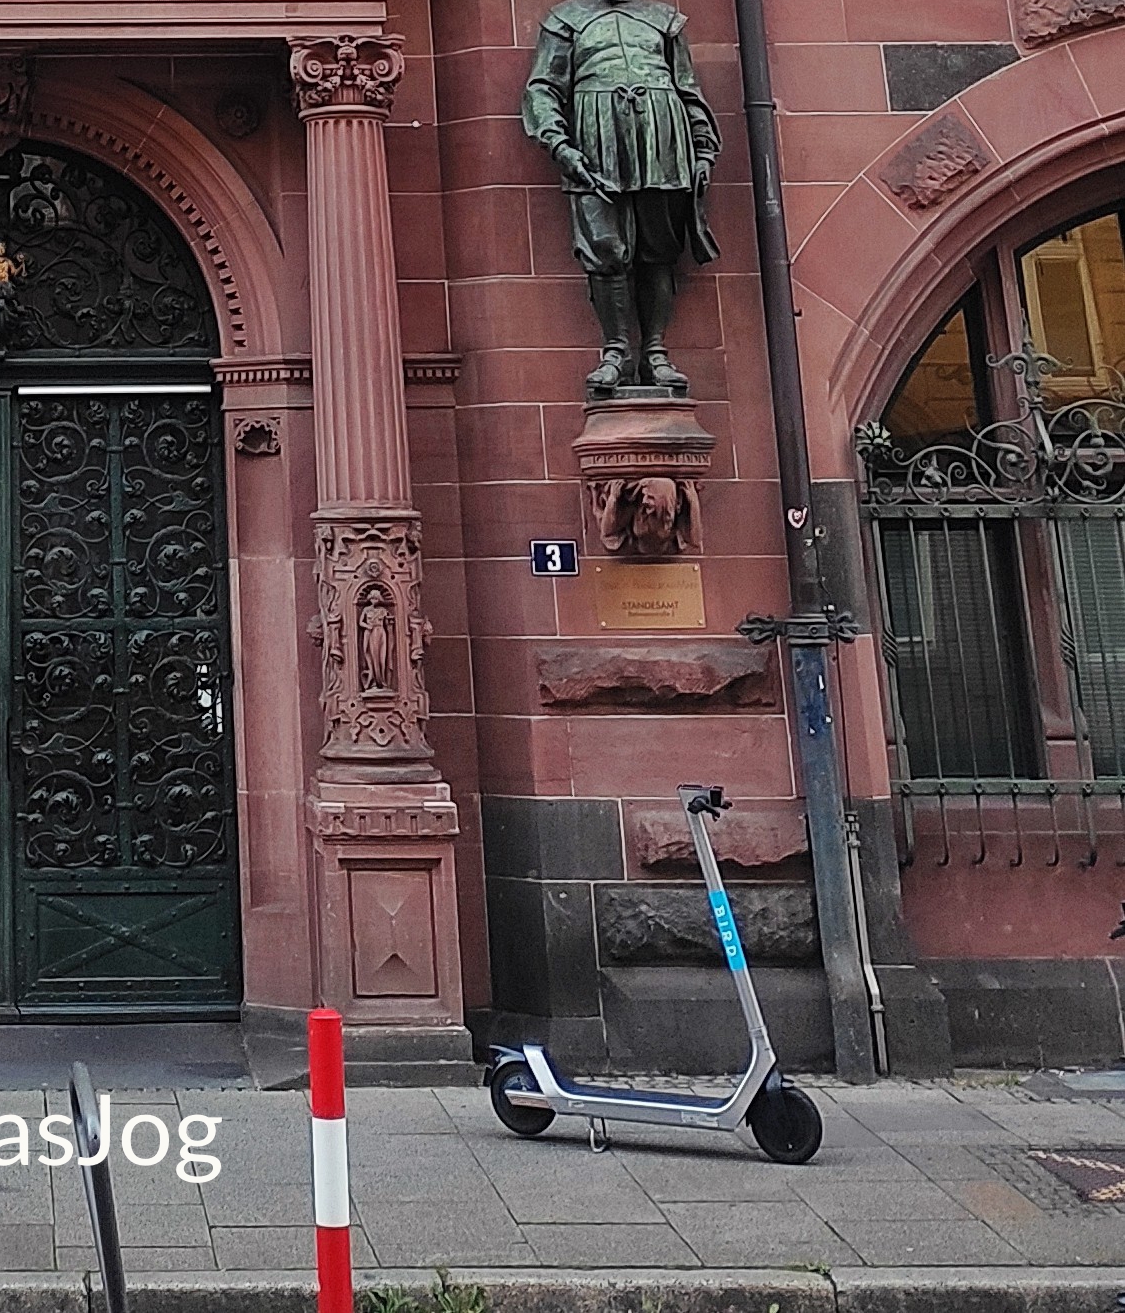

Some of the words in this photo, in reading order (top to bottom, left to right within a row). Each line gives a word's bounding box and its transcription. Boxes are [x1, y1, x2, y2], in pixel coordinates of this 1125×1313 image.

[545, 544, 562, 571] 3
[621, 600, 679, 610] STANDESAMT
[715, 905, 737, 957] BIRD
